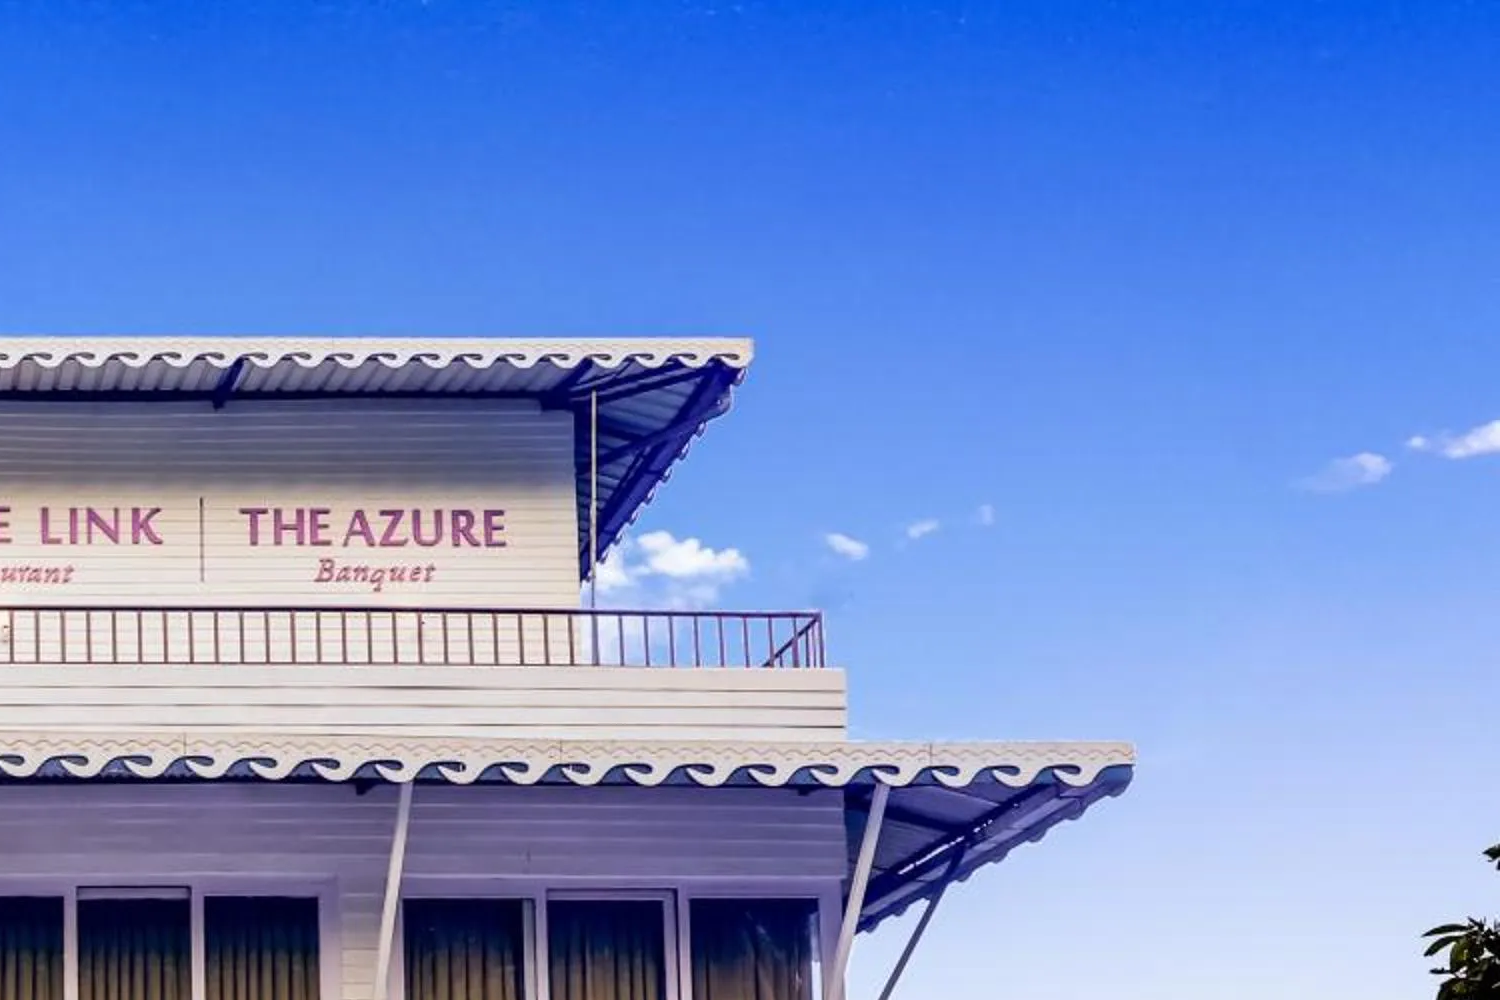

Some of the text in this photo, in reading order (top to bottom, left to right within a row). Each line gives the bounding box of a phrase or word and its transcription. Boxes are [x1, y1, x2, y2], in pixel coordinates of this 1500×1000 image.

[41, 507, 163, 545] LINK
[239, 508, 507, 547] THE AZURE
[314, 557, 437, 592] Banquet
